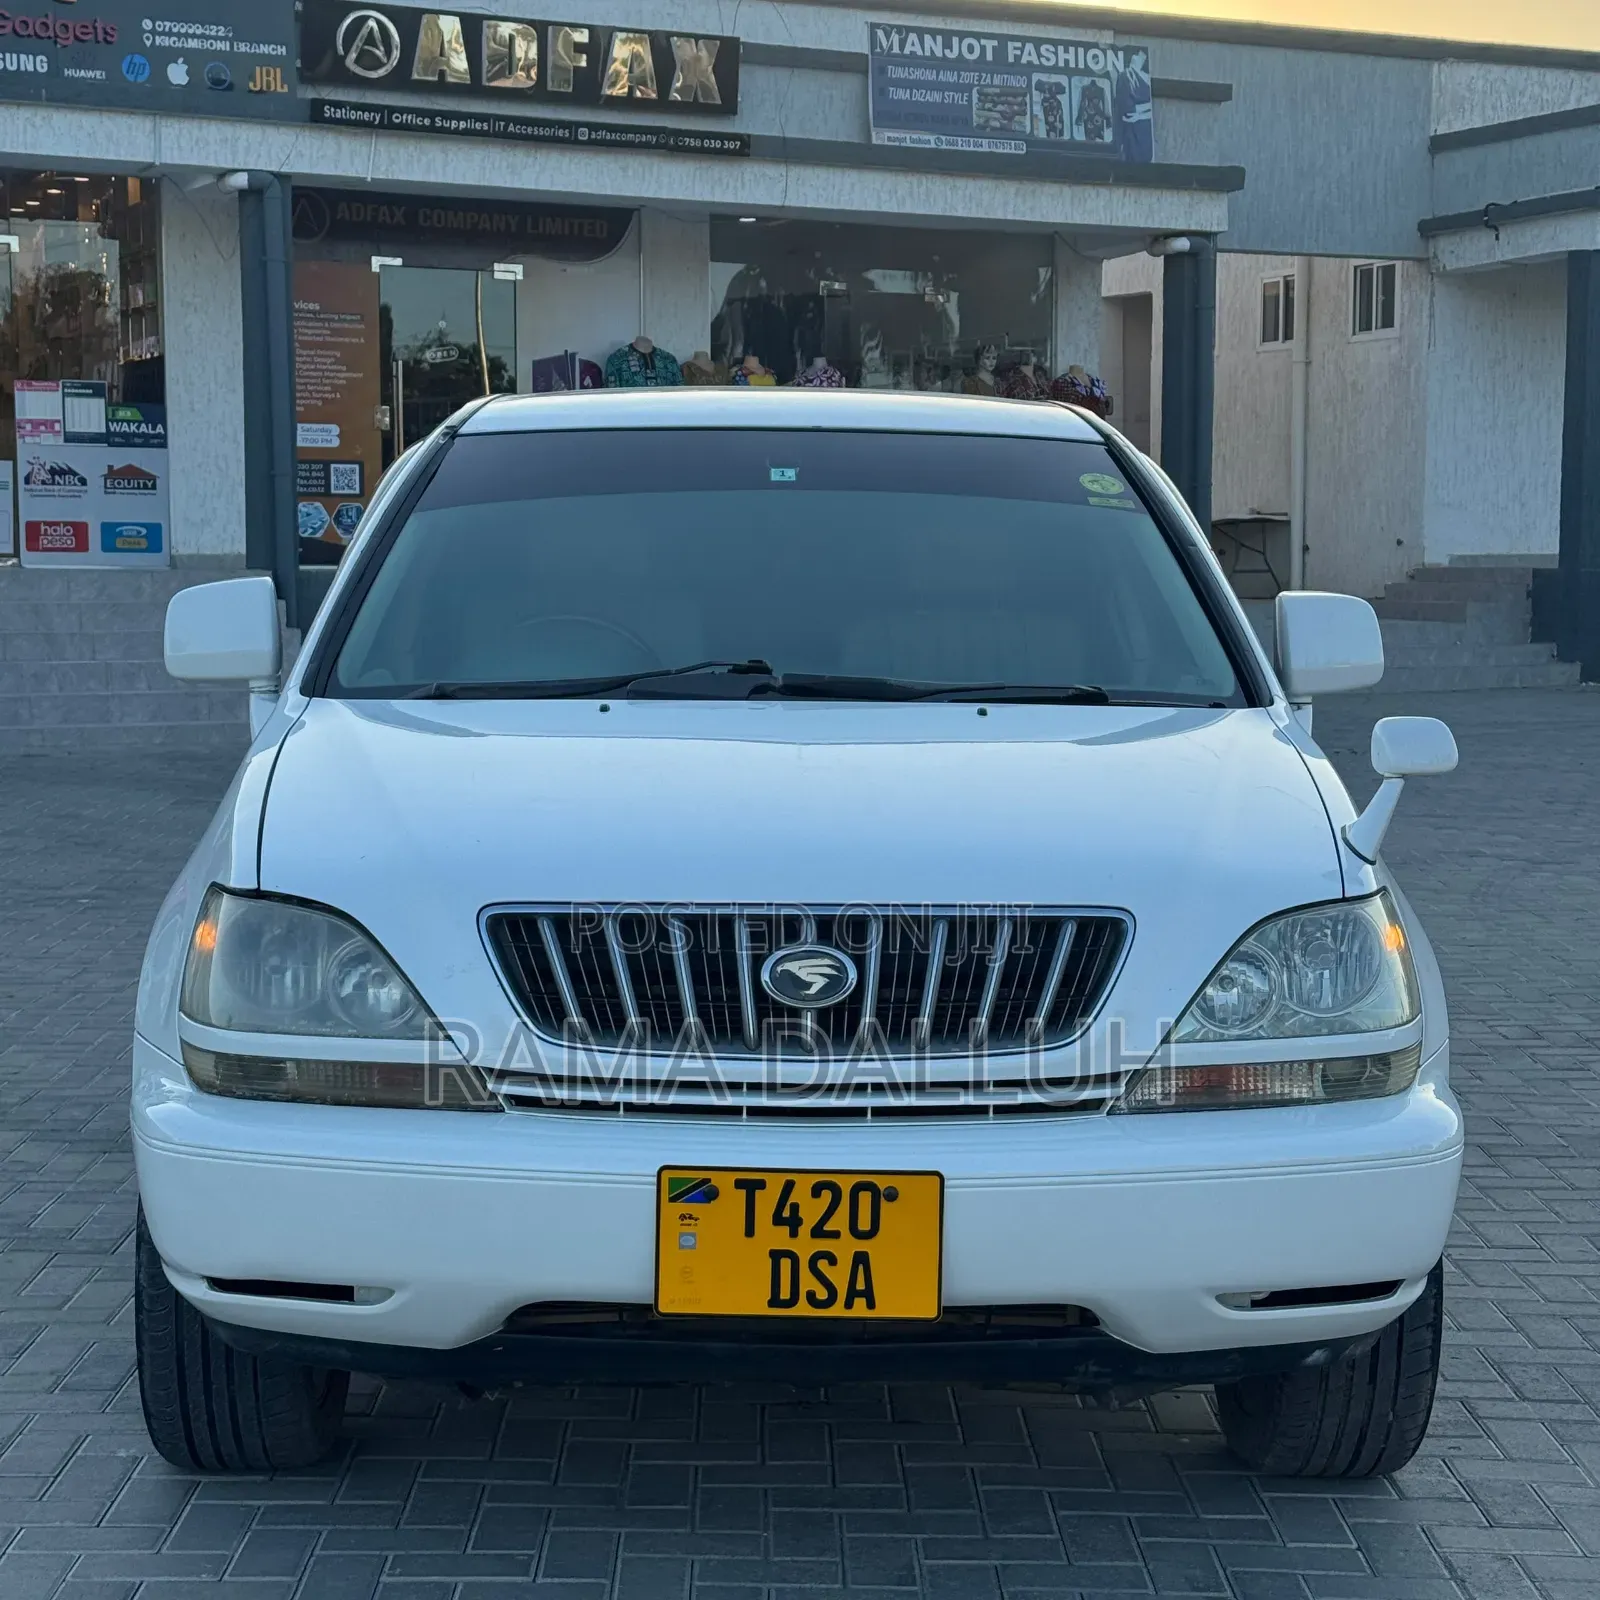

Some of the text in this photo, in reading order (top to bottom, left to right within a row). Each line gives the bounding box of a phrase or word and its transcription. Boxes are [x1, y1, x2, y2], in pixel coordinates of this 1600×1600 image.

[0, 10, 119, 45] Gadgets
[154, 35, 287, 56] KIGAMBONI BRANCH
[875, 25, 1125, 73] MANJOT FASHION
[411, 13, 722, 104] ADFAX
[63, 67, 106, 80] HUAWEI
[249, 66, 289, 93] JBL
[887, 65, 1028, 88] TUNASHONA AINA ZOTE ZA MITINDO
[888, 87, 969, 105] TUNA DIZAINI STYLE
[323, 105, 381, 124] Stationery
[392, 112, 431, 126] Office
[434, 116, 489, 131] Supplies
[495, 121, 506, 132] IT
[507, 122, 570, 138] Accessories
[590, 131, 657, 144] adfaxcompany
[703, 139, 721, 148] 030
[723, 140, 741, 149] 307
[336, 201, 609, 239] ADFAX COMPANY LIMITED
[108, 421, 165, 434] WAKALA
[300, 425, 332, 434] Saturday
[54, 474, 82, 486] NBC
[106, 479, 154, 489] EQUITY
[40, 522, 74, 535] halo
[40, 537, 75, 549] pesa
[734, 1178, 881, 1240] T420
[767, 1248, 876, 1310] DSA
